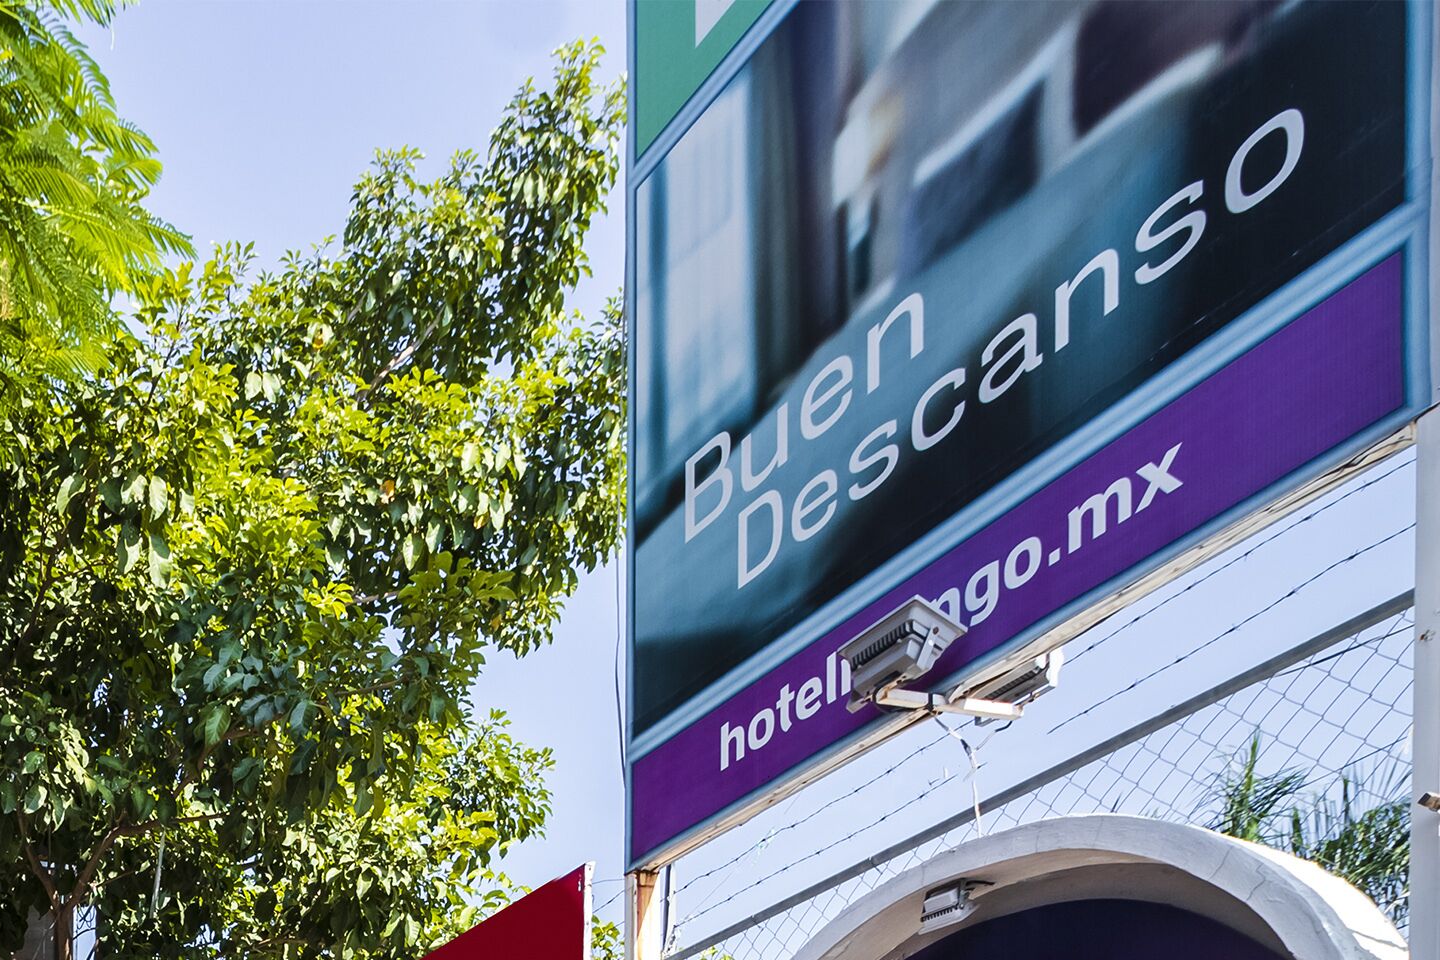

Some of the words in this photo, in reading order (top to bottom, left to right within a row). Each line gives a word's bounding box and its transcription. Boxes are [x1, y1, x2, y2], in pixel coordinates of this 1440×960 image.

[685, 293, 924, 544] Buen
[737, 108, 1305, 589] Descanso
[720, 442, 1184, 771] hotelngo.mx
